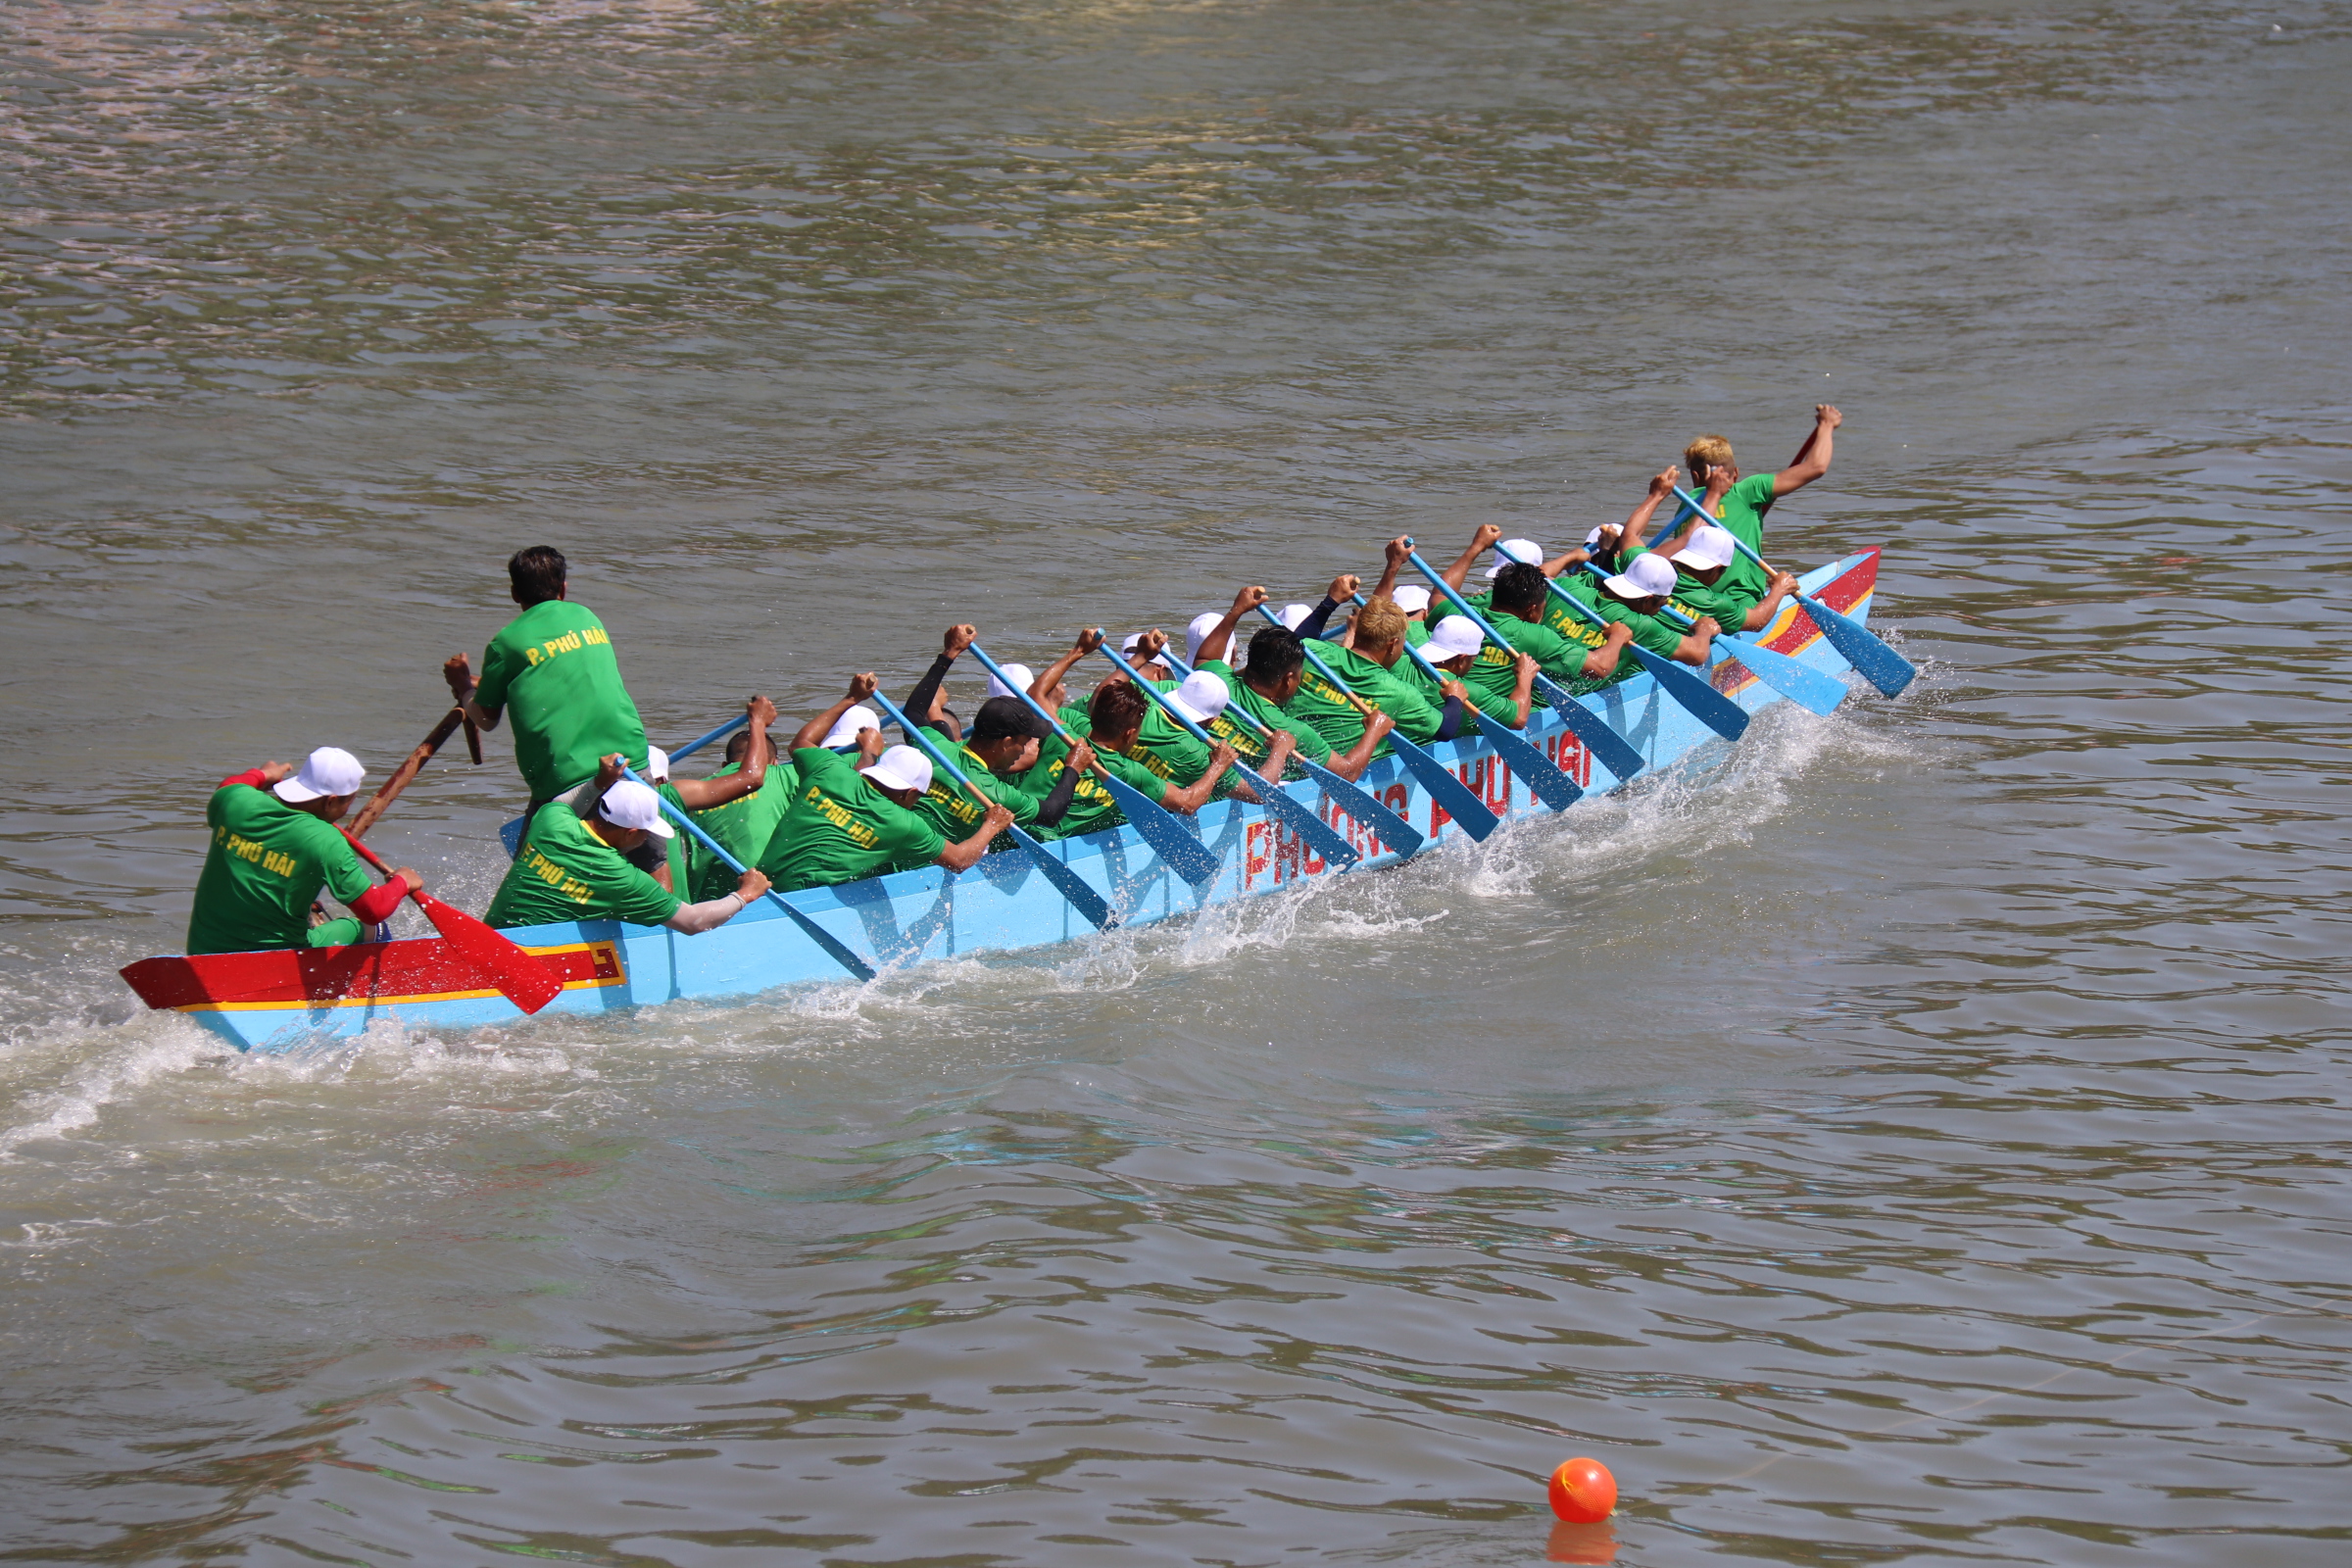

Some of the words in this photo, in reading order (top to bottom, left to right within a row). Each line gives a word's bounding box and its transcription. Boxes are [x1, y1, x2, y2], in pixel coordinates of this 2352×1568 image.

[525, 648, 545, 666] P.
[543, 630, 581, 658] PHÚ
[1048, 760, 1065, 777] P.
[805, 785, 821, 806] P.
[816, 797, 854, 827] PHÚ
[225, 833, 264, 862] PHÚ
[527, 853, 565, 885] PHÚ
